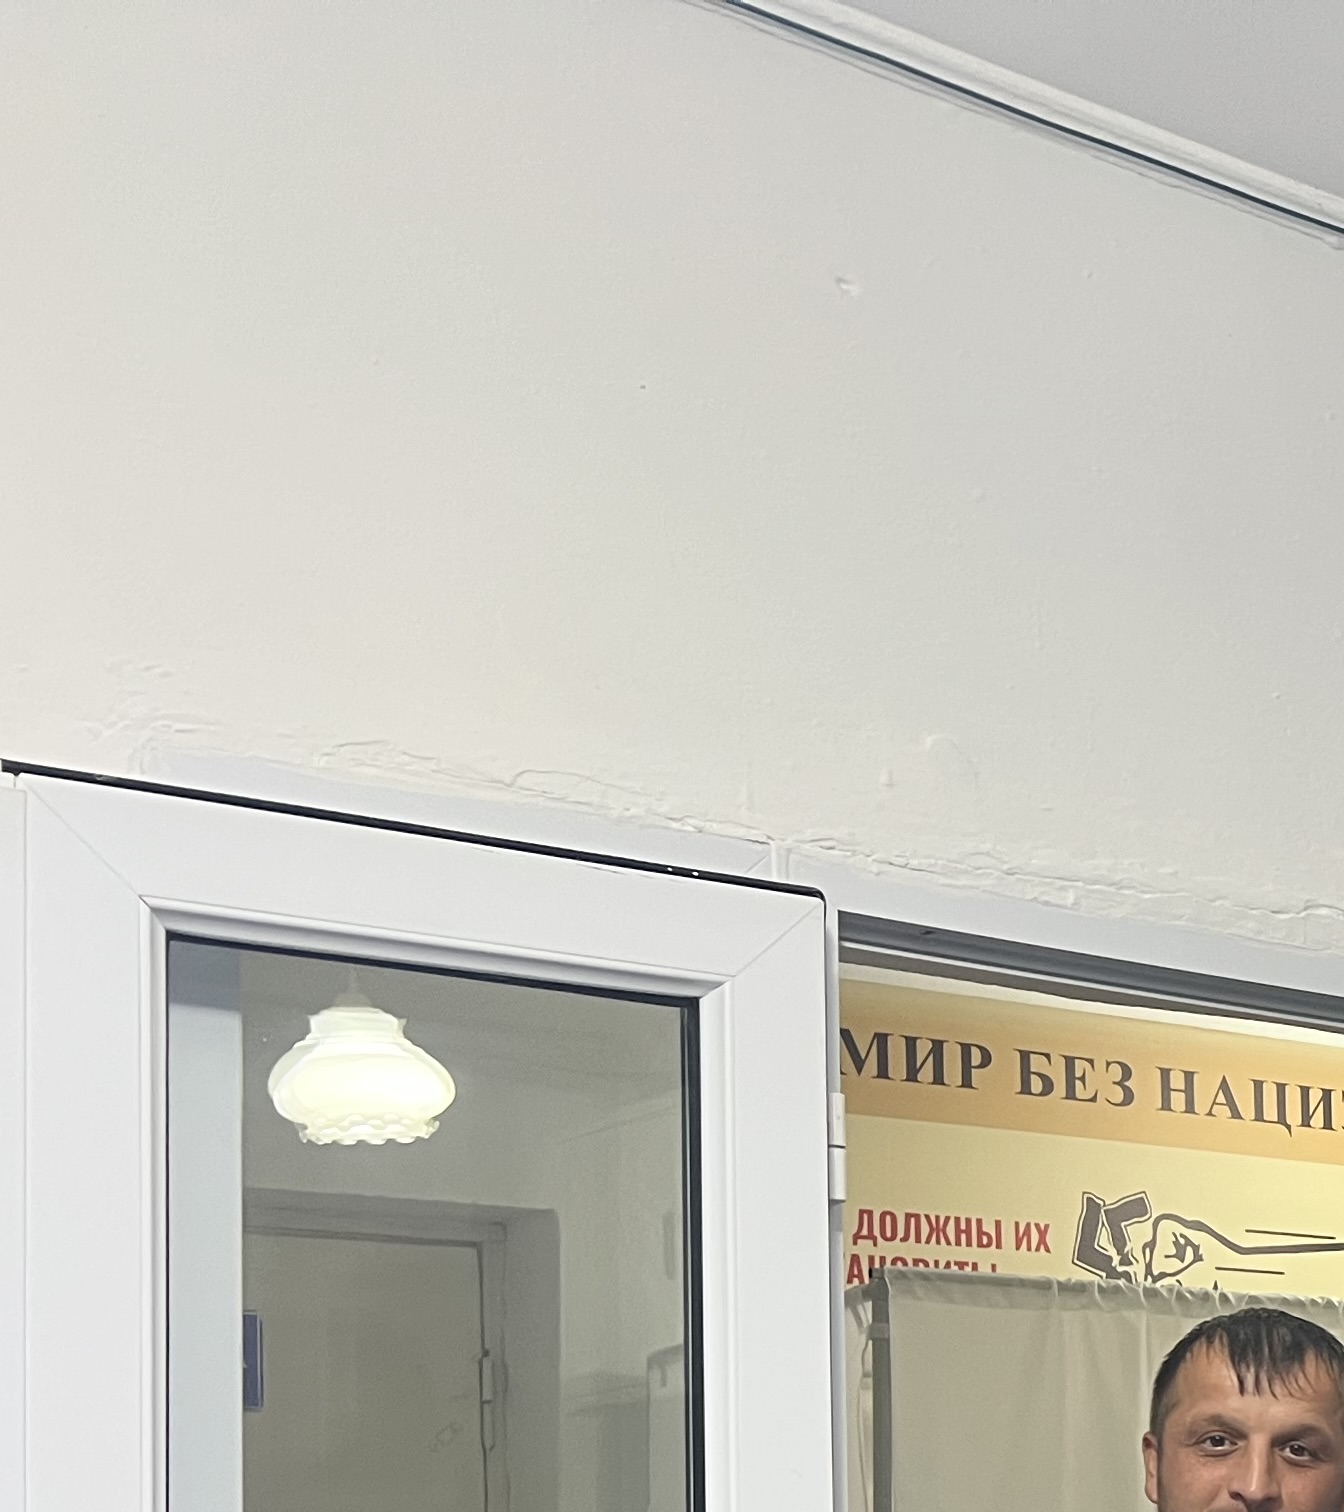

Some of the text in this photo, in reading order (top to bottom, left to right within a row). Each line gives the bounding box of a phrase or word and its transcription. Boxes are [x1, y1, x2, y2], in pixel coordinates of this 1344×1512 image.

[839, 1028, 992, 1090] МИР
[1014, 1048, 1135, 1107] БЕЗ
[852, 1208, 1052, 1254] ДОЛЖНЫ ИХ
